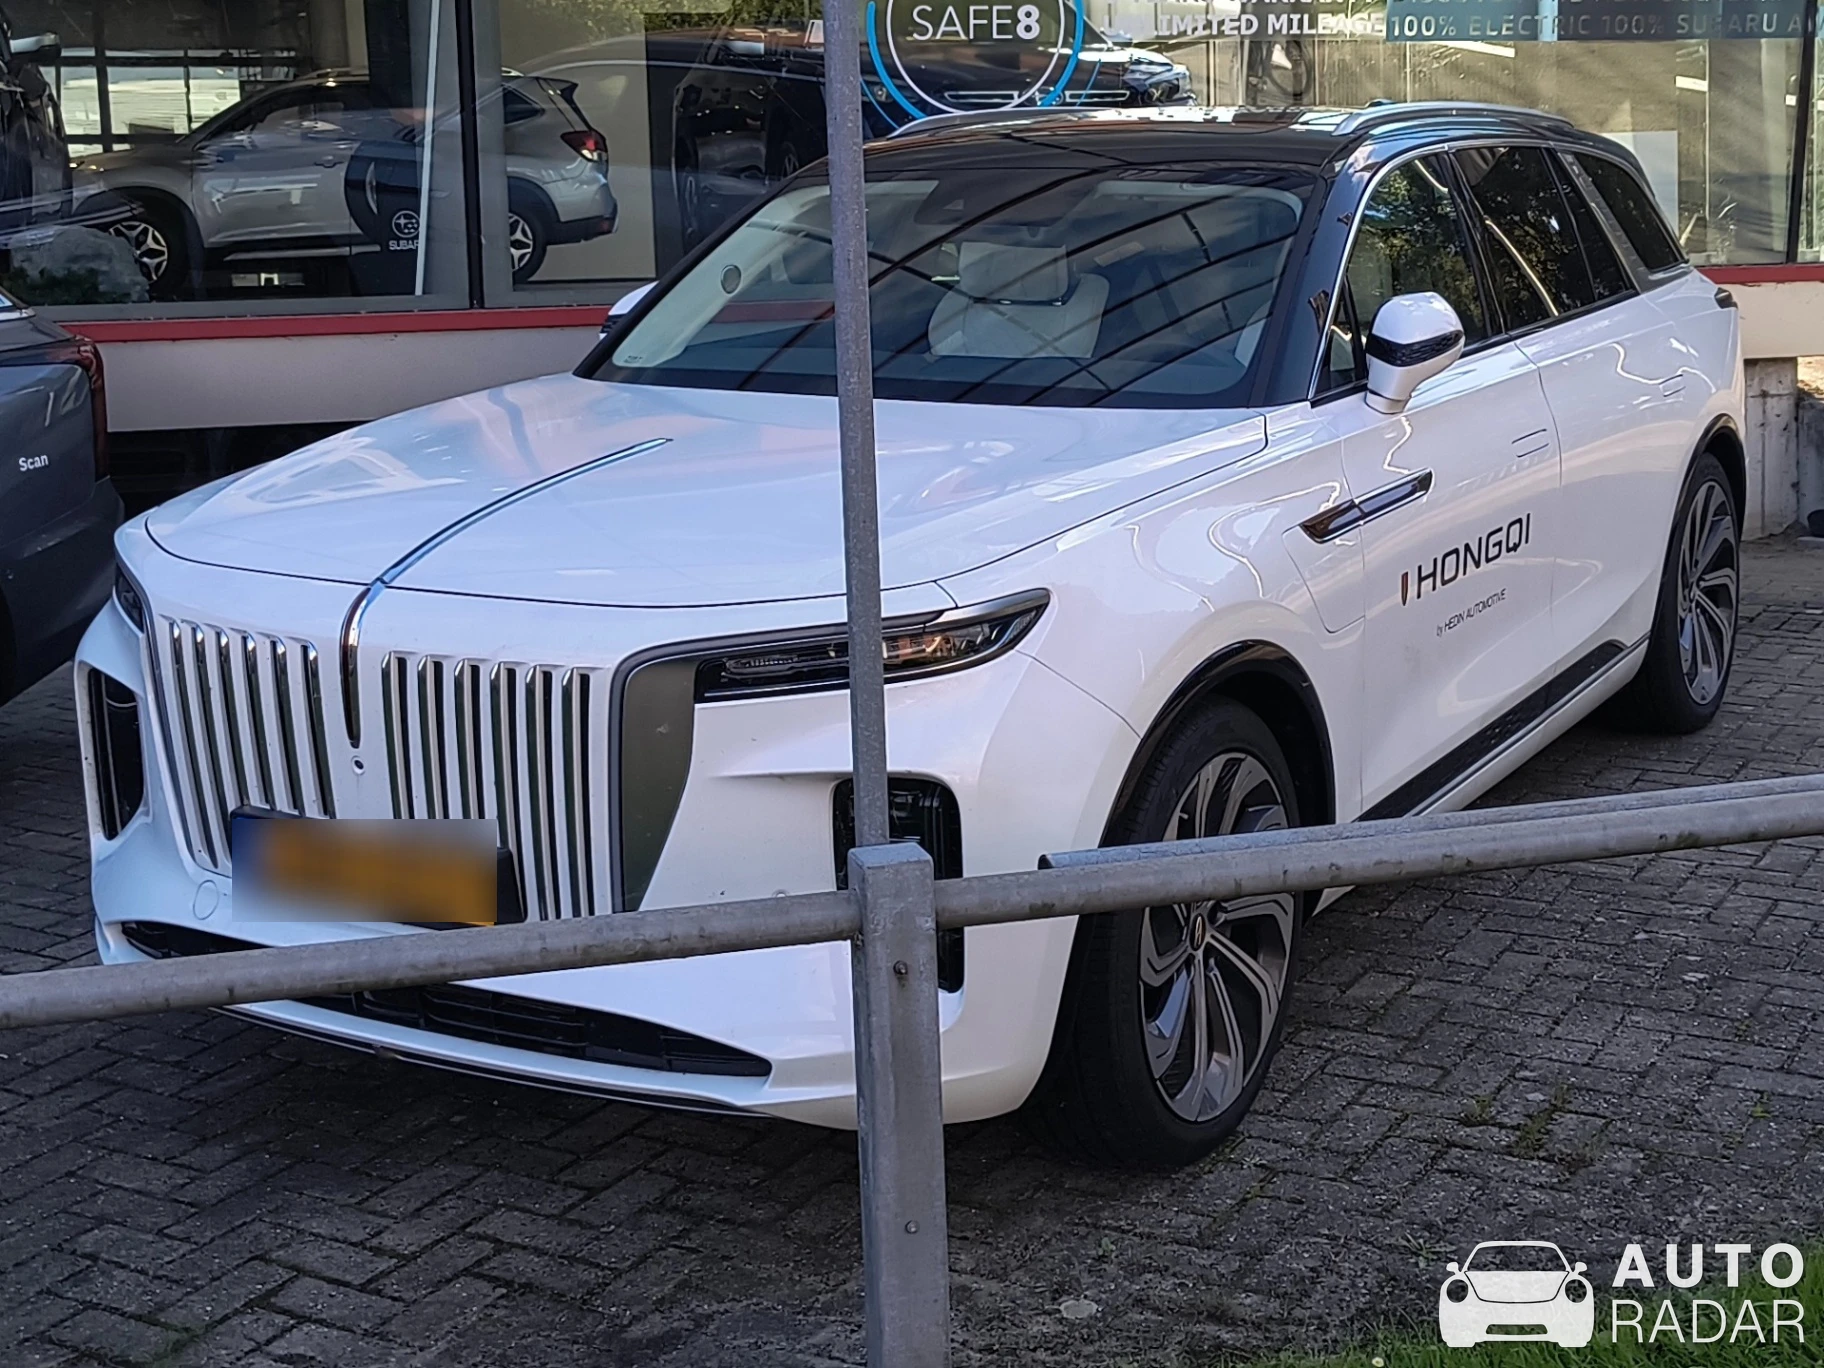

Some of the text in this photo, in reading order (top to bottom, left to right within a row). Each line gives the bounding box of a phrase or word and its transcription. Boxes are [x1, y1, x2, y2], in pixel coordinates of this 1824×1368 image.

[912, 4, 1040, 40] SAFE8
[1102, 13, 1385, 36] UIMITED MILEAGE
[1391, 14, 1457, 37] 100%
[1469, 14, 1591, 36] ELECTRIC
[1601, 14, 1664, 35] 100%
[388, 240, 420, 250] SUBAR
[19, 454, 49, 471] Scan
[1416, 513, 1531, 600] HONGQI
[1466, 587, 1507, 620] AUTOMOTIVE
